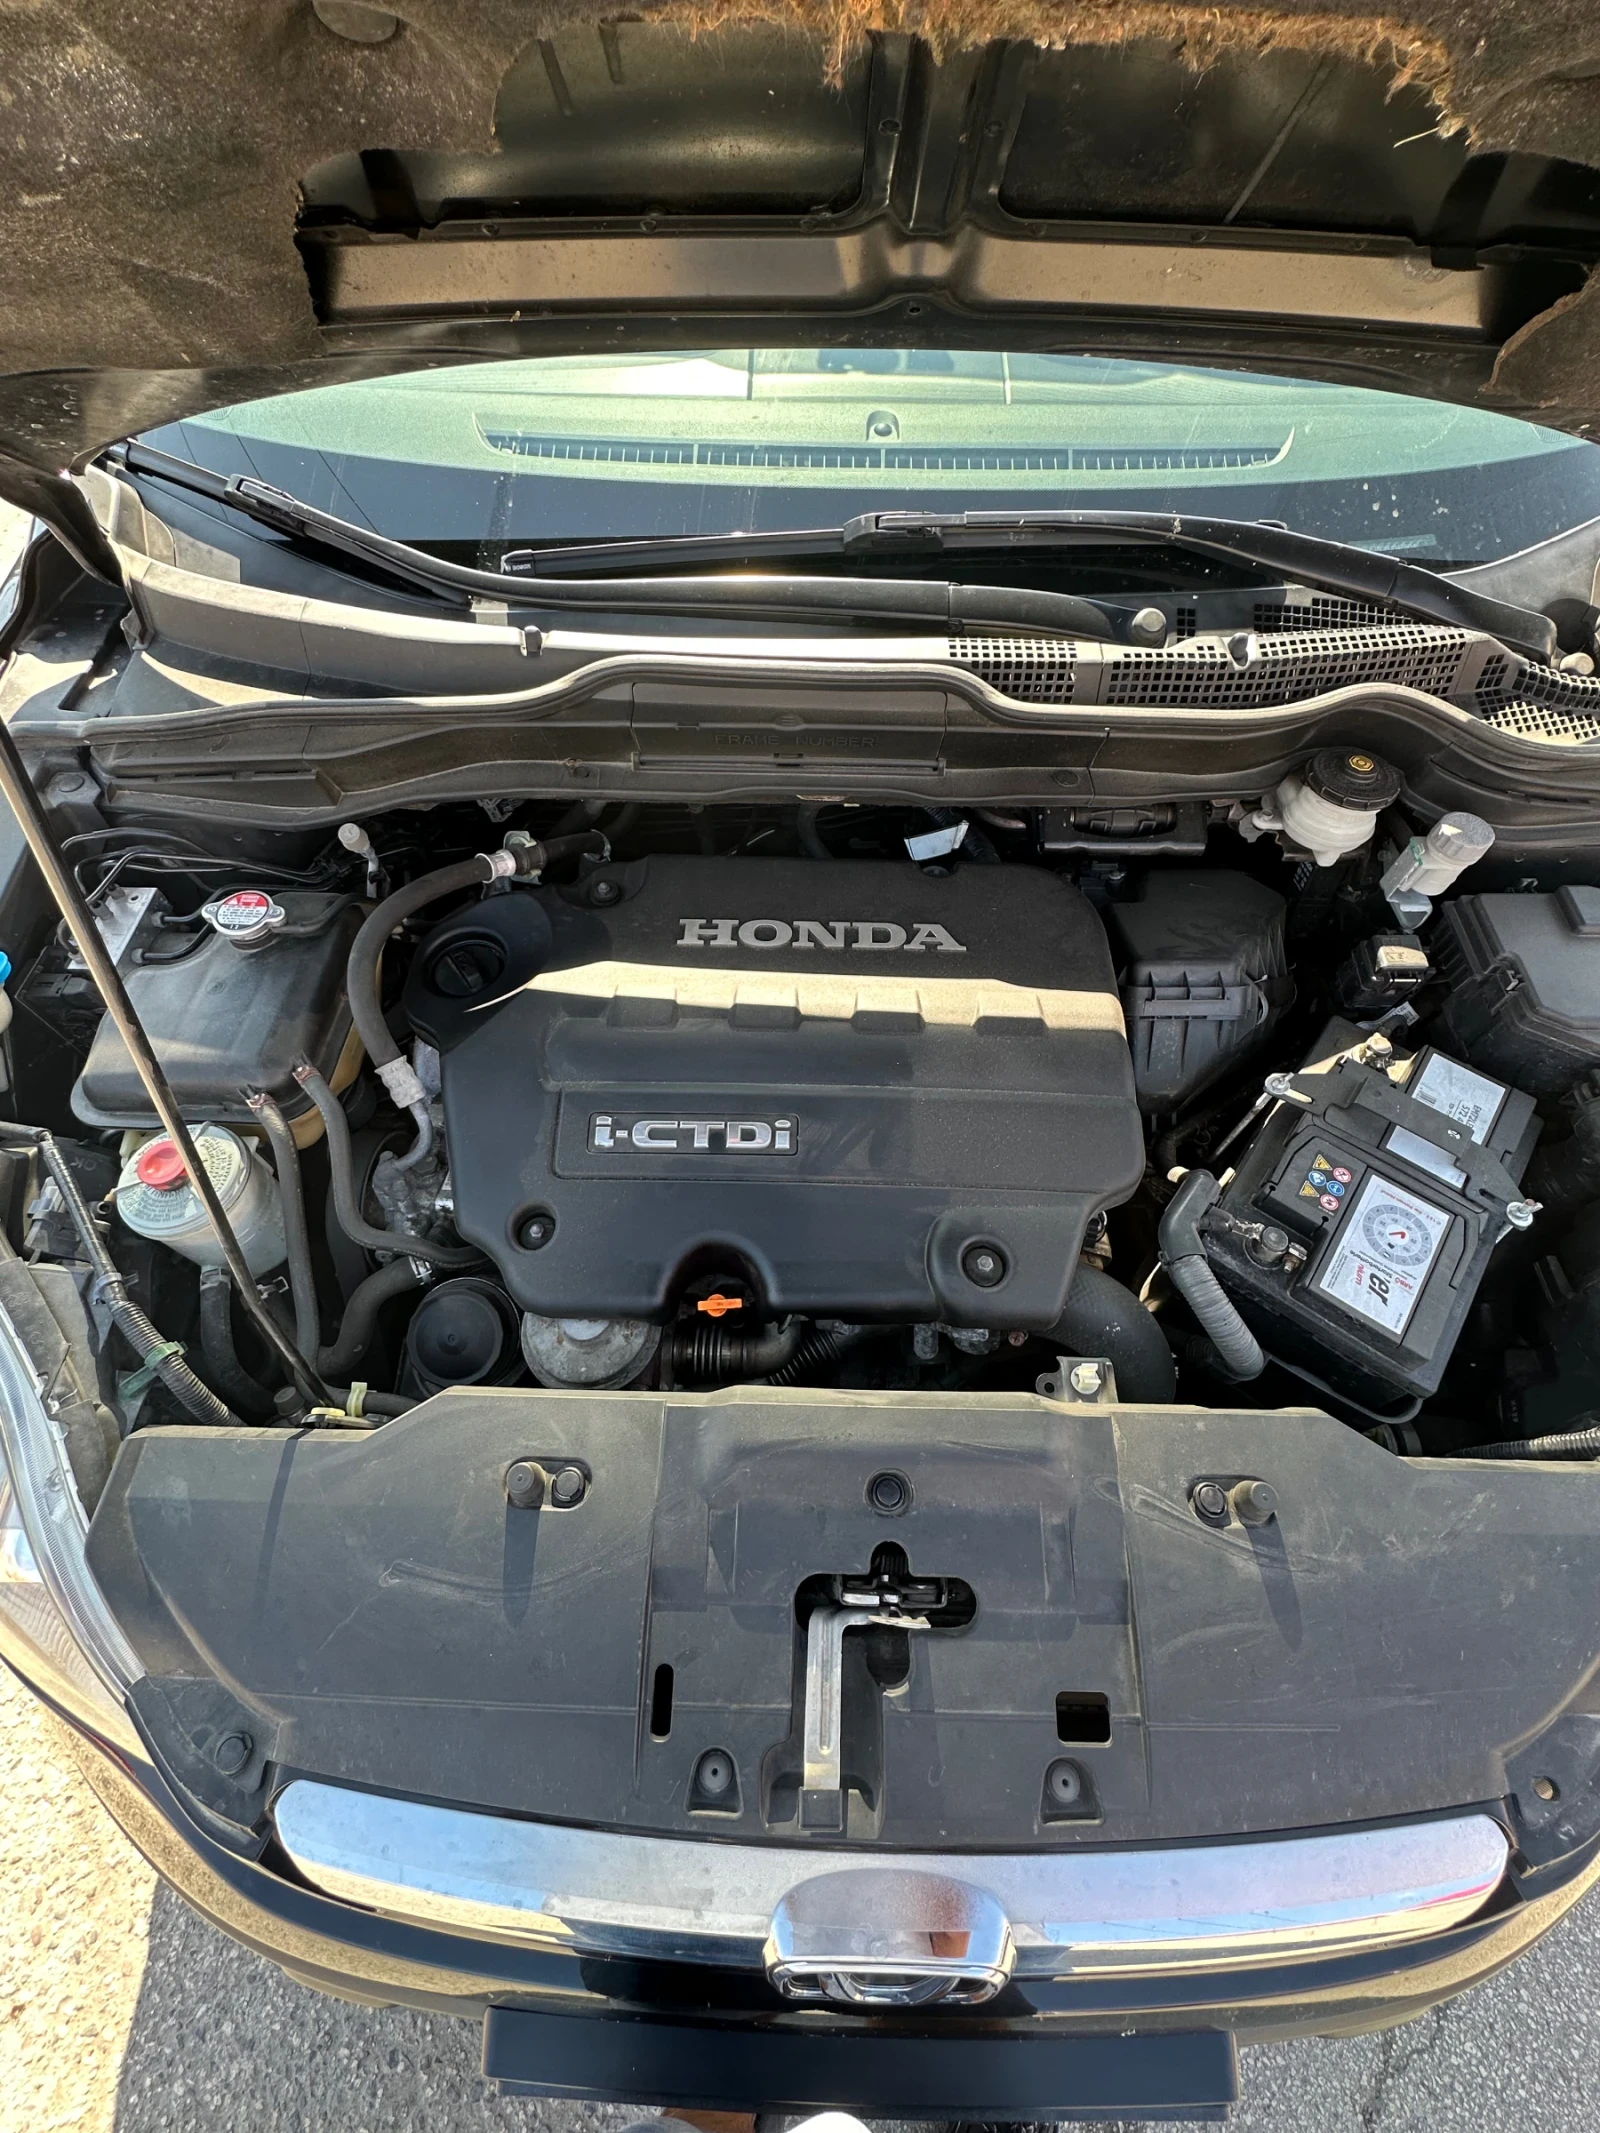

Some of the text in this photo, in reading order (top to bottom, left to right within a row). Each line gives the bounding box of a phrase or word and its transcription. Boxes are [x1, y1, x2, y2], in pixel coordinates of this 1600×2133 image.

[715, 734, 875, 748] FRAME NUMBER
[676, 918, 967, 951] HONDA
[594, 1115, 792, 1149] i-CTDi
[1349, 1249, 1393, 1279] Starterbatterie
